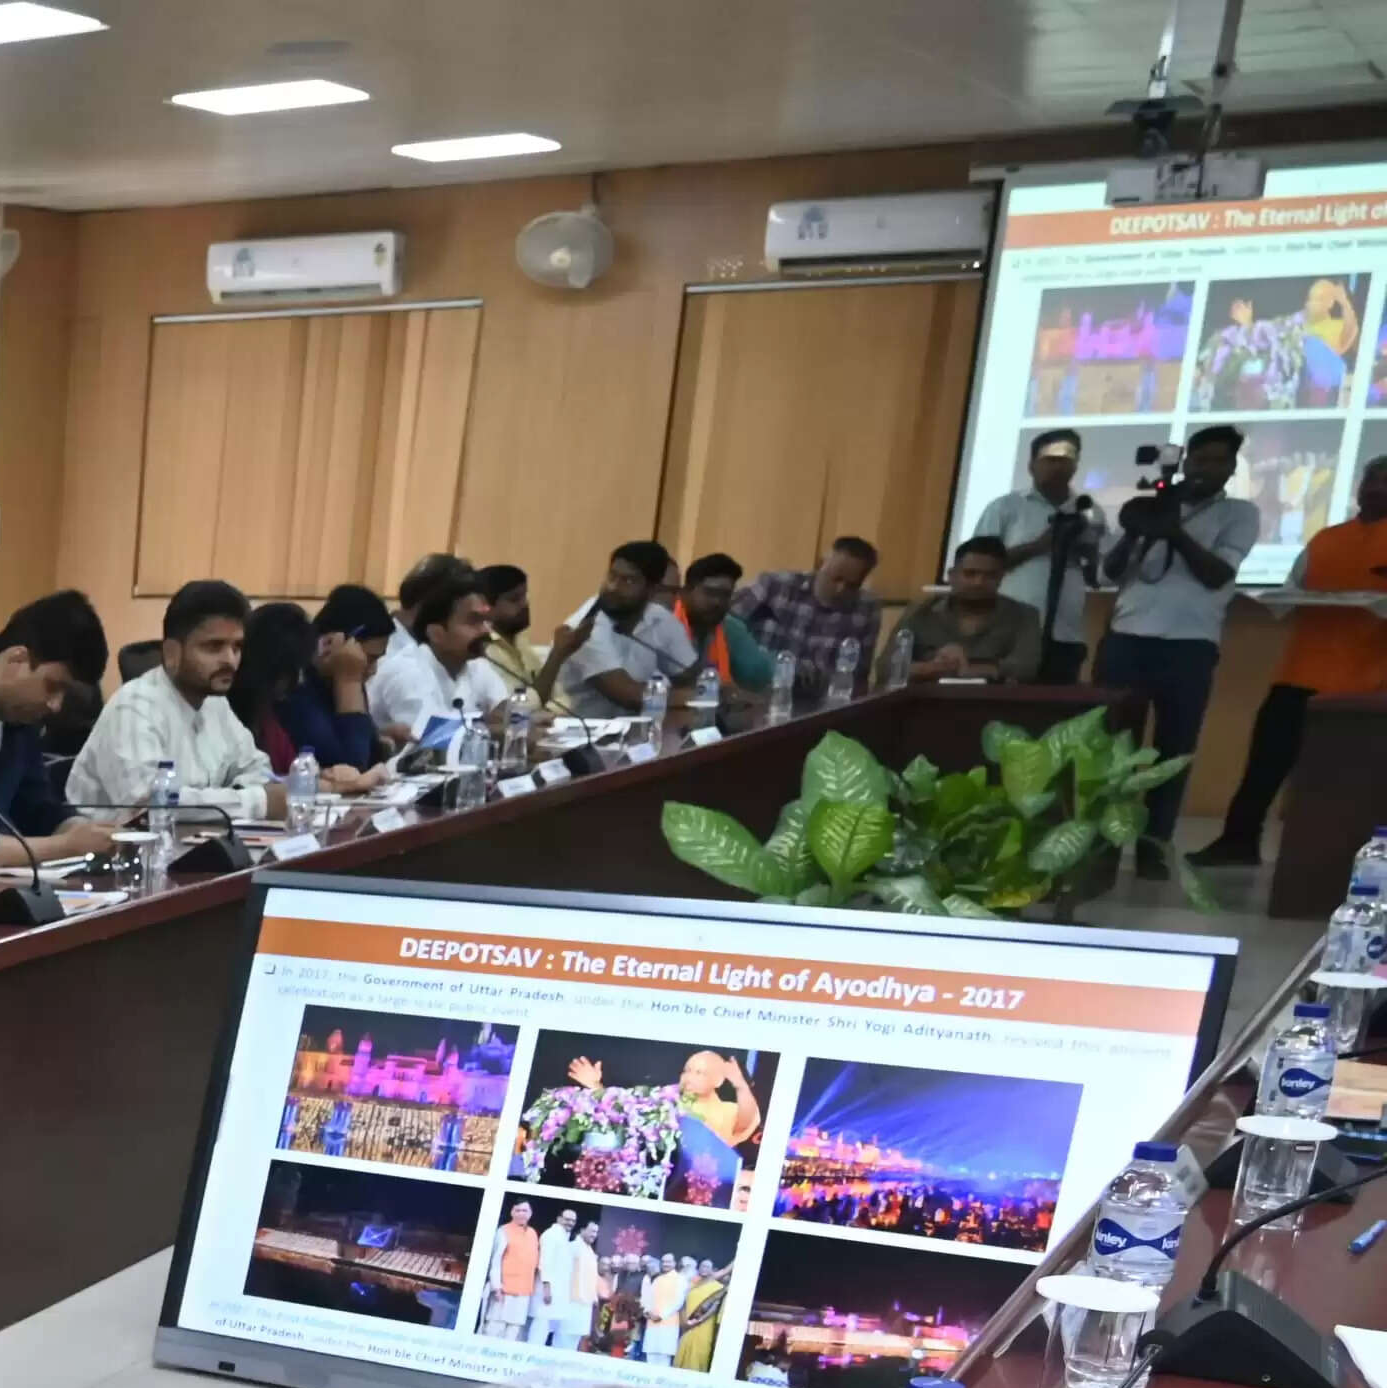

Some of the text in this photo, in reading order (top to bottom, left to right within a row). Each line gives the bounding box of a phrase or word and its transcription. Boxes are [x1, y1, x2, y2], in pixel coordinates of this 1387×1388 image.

[1110, 211, 1211, 236] DEEPOTSAV
[1224, 209, 1255, 229] The
[1259, 204, 1321, 227] Eternal
[1324, 201, 1368, 226] Light
[363, 972, 444, 993] Government
[449, 981, 465, 994] of
[469, 982, 505, 998] Uttar
[712, 1004, 752, 1022] Chief
[757, 1009, 821, 1027] Minister
[827, 1015, 857, 1031] Shri
[864, 1018, 896, 1037] Yogi
[399, 937, 542, 968] DEEPOTSAV
[545, 953, 555, 970] :
[561, 950, 607, 975] The
[611, 955, 704, 983] Eternal
[708, 963, 773, 991] Light
[778, 968, 811, 991] of
[812, 972, 937, 1006] Ayodhya
[959, 986, 1025, 1009] 2017
